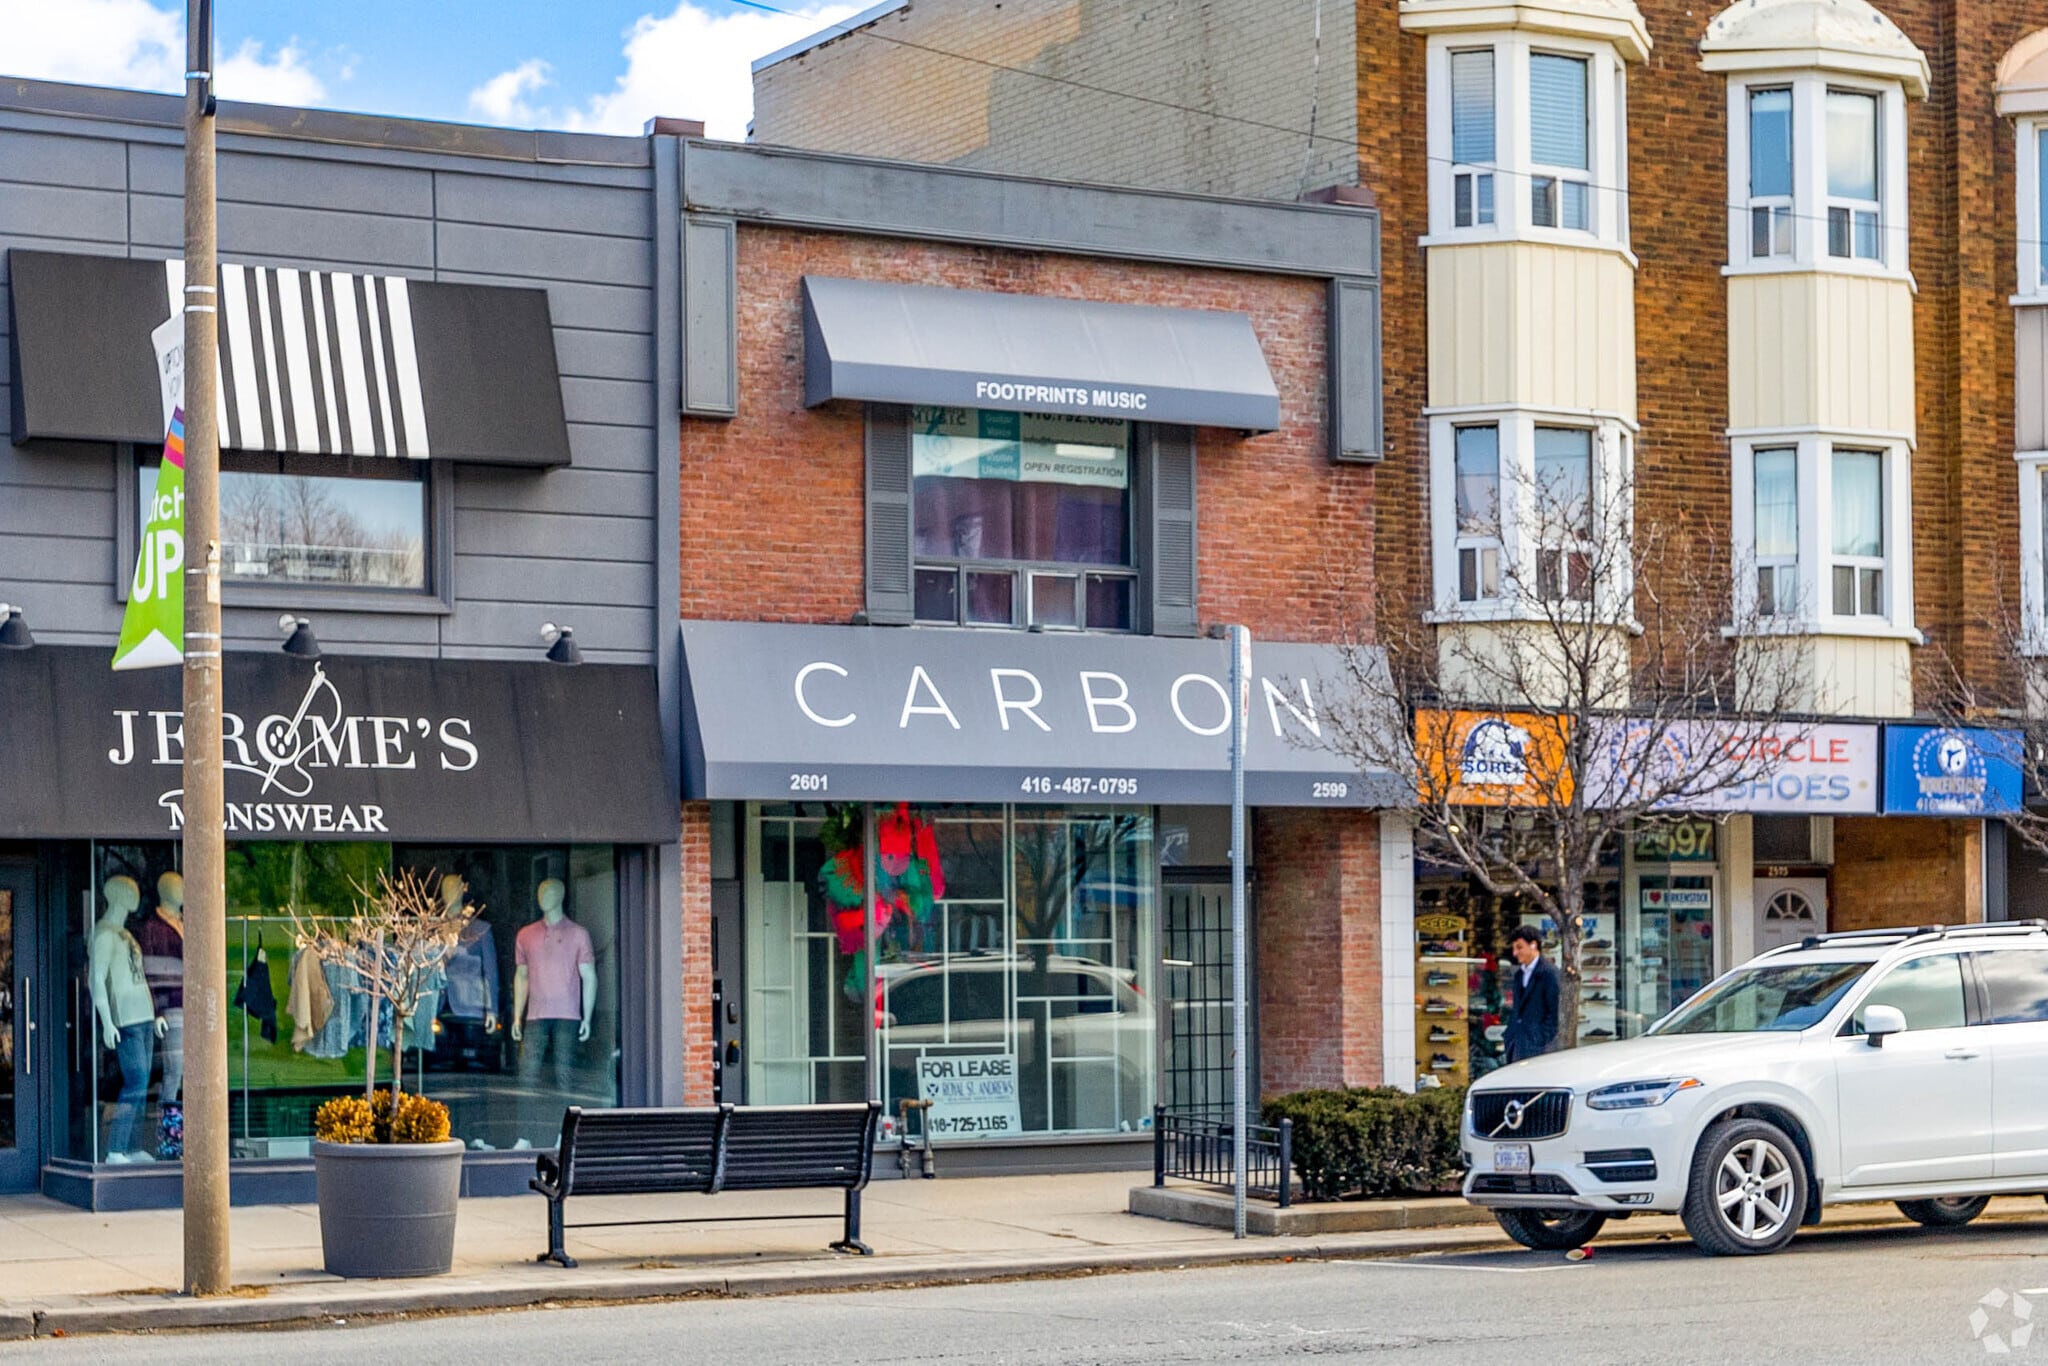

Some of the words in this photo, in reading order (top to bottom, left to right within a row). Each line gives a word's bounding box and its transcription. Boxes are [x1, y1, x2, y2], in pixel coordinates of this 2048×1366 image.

[976, 381, 1089, 405] FOOTPRINTS
[1092, 390, 1147, 410] MUSIC
[1024, 462, 1051, 472] OPEN
[1053, 463, 1124, 477] REGISTRATION
[133, 529, 184, 603] UP
[794, 660, 1322, 738] CARBON
[108, 709, 479, 772] JEROME'S
[1724, 735, 1850, 763] CIRCLE
[790, 774, 829, 791] 2601
[1020, 776, 1138, 795] 416-487-0795
[1312, 782, 1348, 798] 2599
[1724, 773, 1851, 801] SHOES
[160, 790, 389, 833] NSWEAR
[921, 1061, 954, 1078] FOR
[957, 1059, 1012, 1077] LEASE
